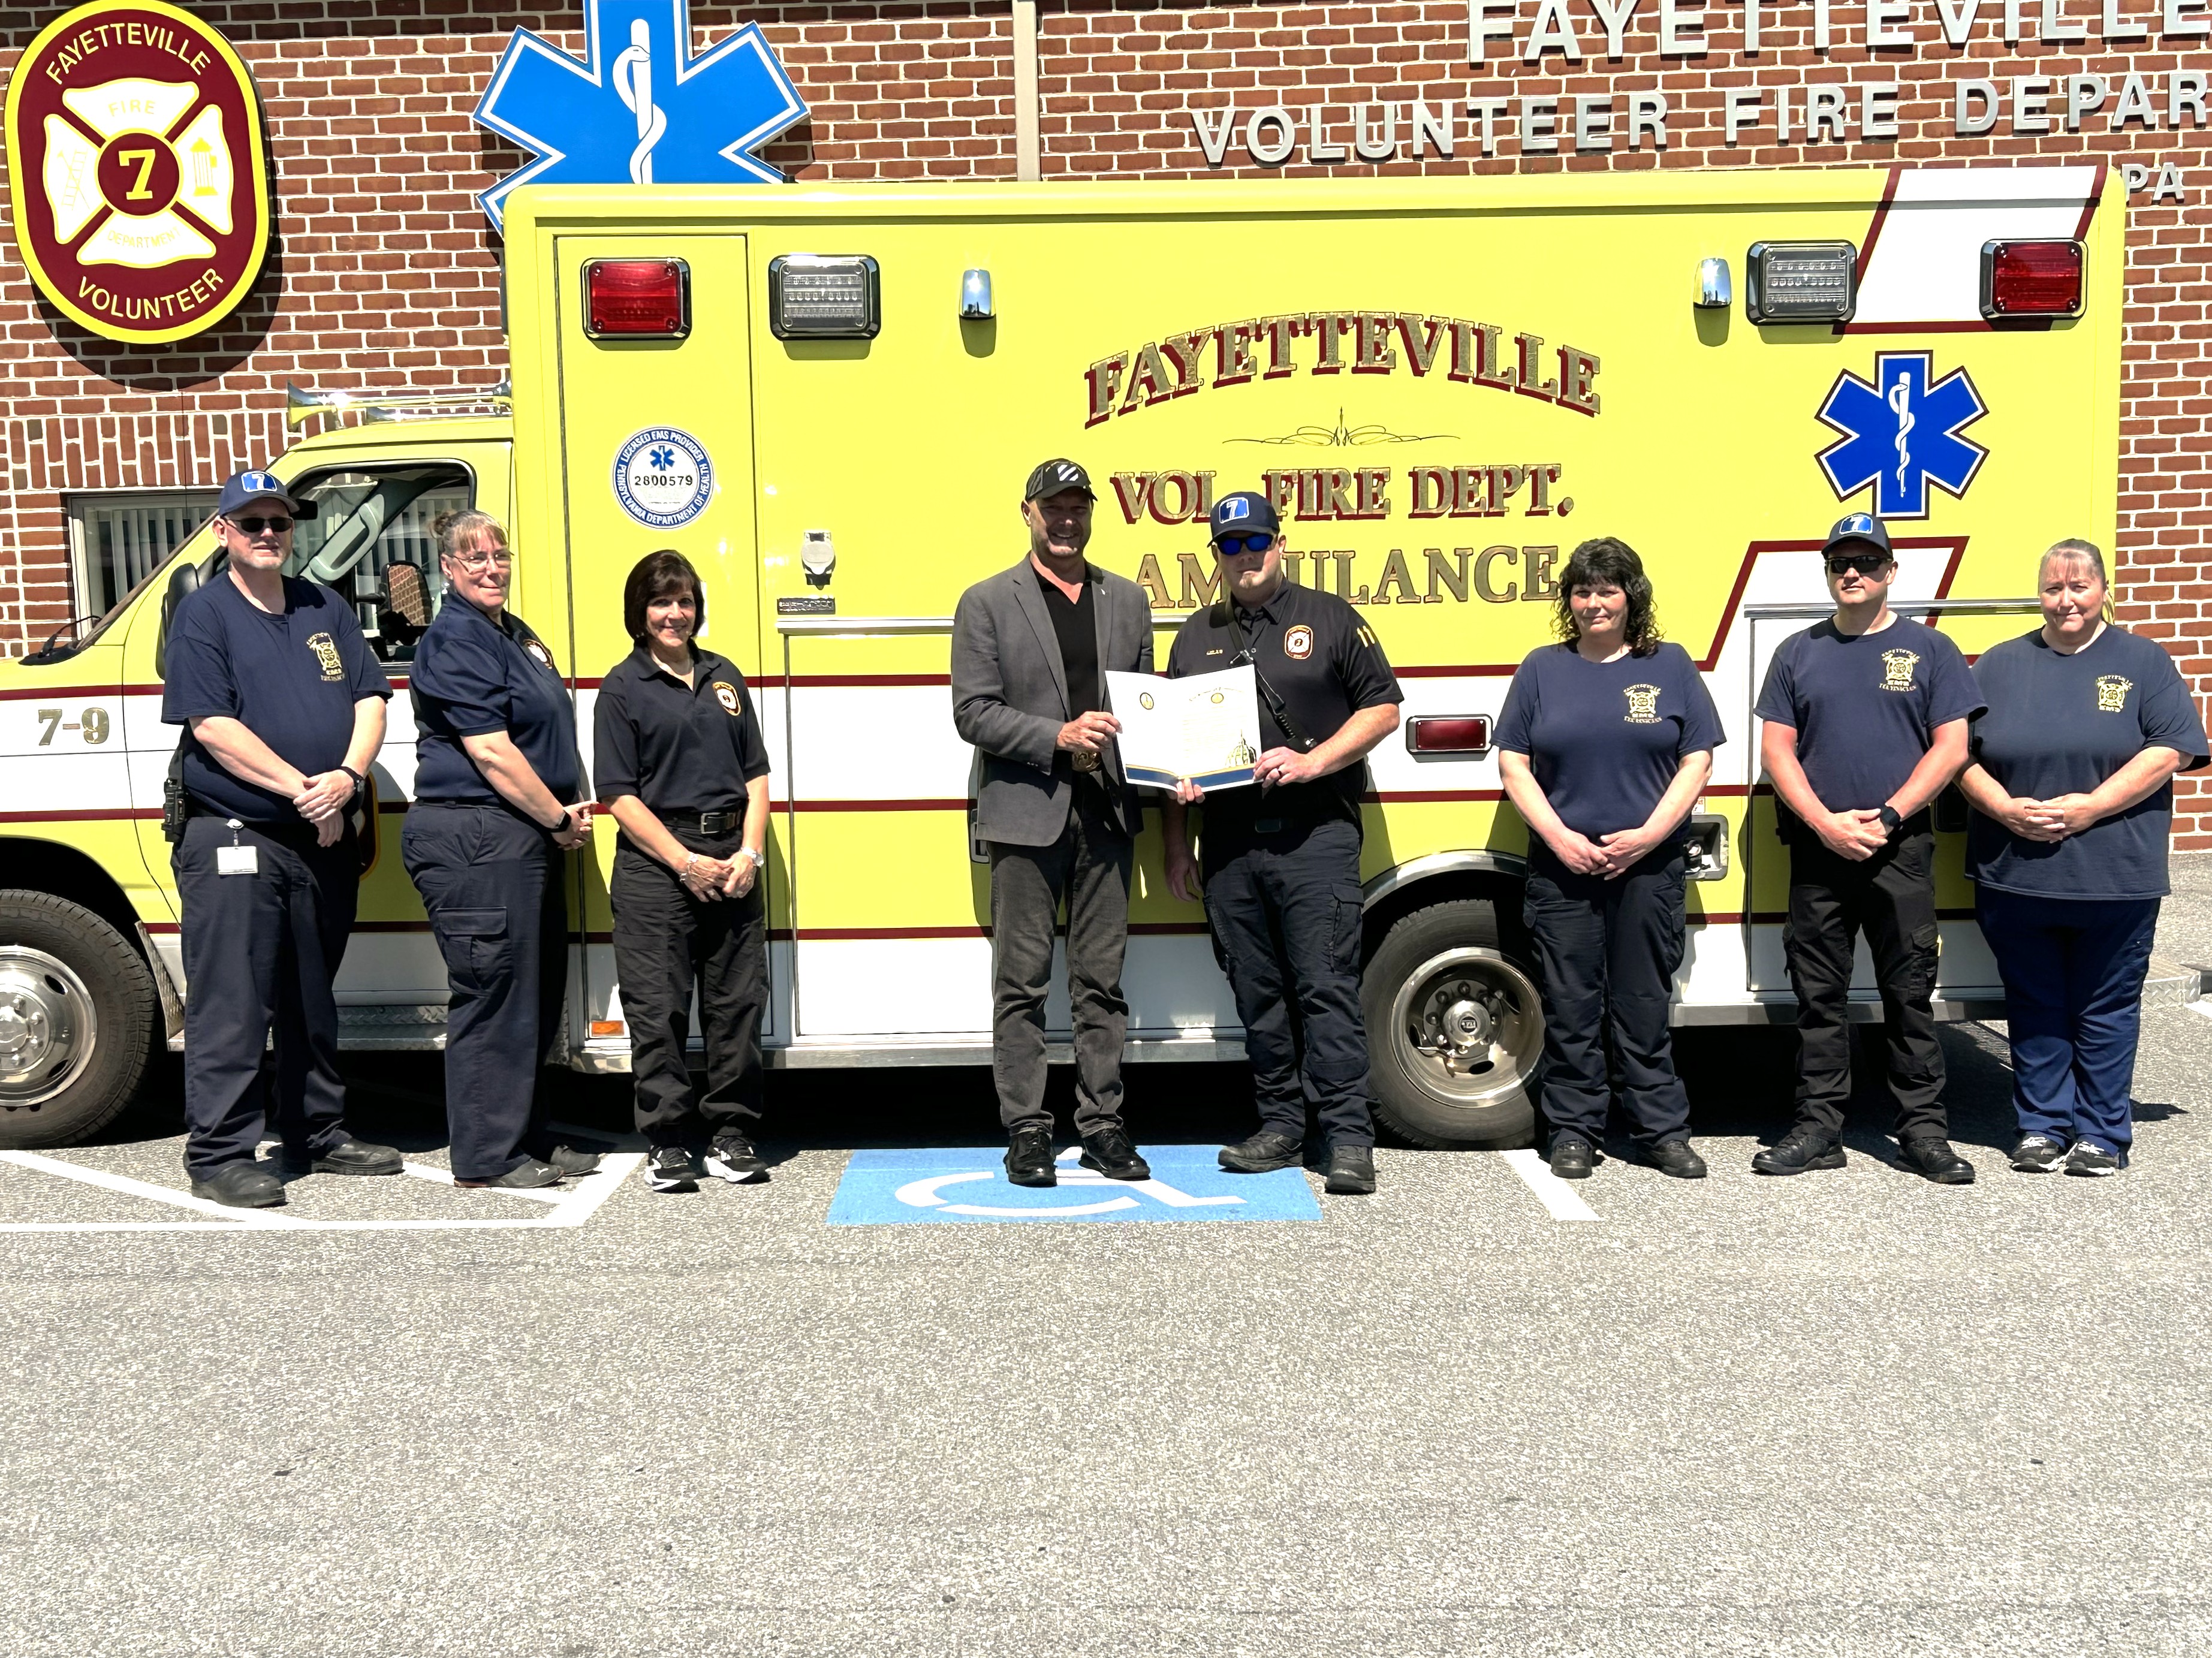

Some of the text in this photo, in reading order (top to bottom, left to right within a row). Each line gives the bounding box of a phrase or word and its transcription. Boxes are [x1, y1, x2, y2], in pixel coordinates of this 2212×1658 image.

[46, 22, 212, 85] FAYETTEVILLE
[108, 99, 156, 117] FIRE
[1191, 72, 2208, 165] VOLUNTEER FIRE DEPAR
[118, 149, 156, 200] 7
[2121, 162, 2185, 205] PA
[107, 226, 181, 248] DEPARTMENT
[78, 267, 224, 321] VOLUNTEER
[1084, 311, 1601, 429] FAYETTEVILLE
[670, 432, 705, 462] PROVIDER
[251, 474, 264, 489] 7
[634, 475, 693, 486] 2800579
[1262, 467, 1391, 521] FIRE
[1409, 463, 1575, 518] DEPT.
[1226, 500, 1238, 519] 7
[1849, 516, 1864, 531] 7
[1136, 545, 1559, 609] AMULANCE
[38, 707, 109, 746] 7-9
